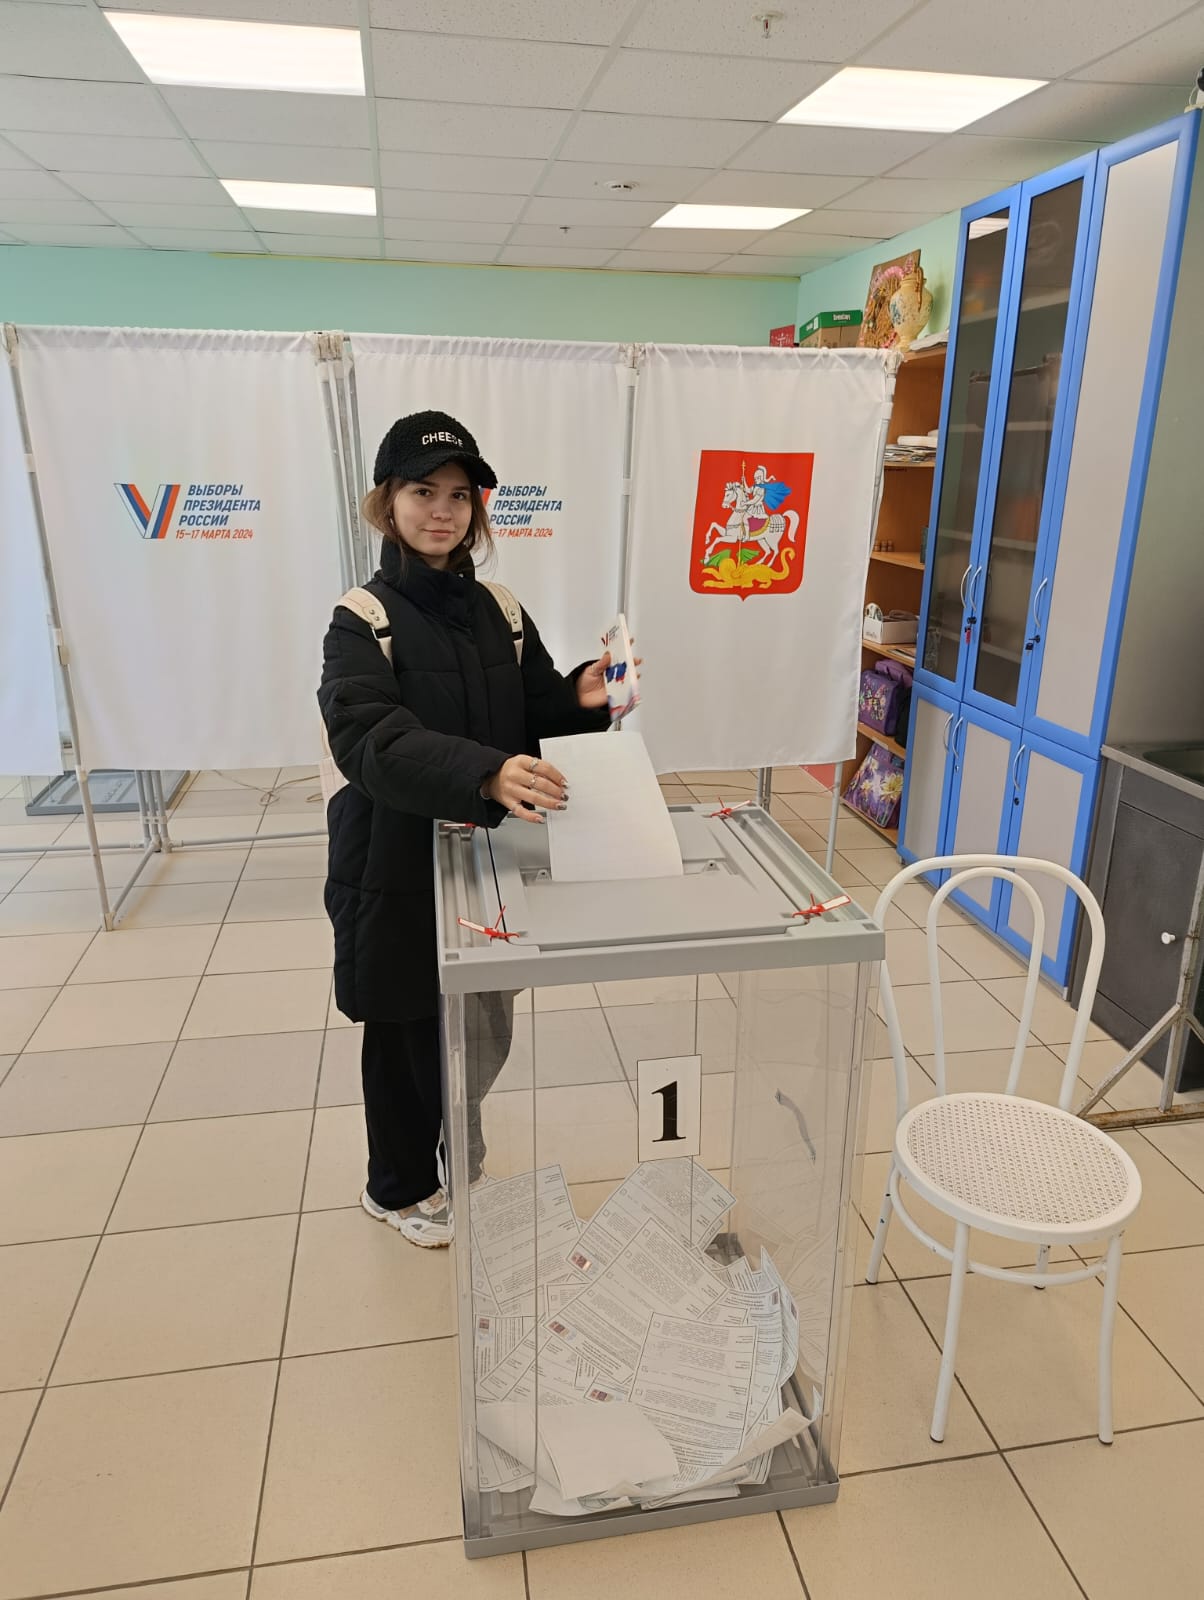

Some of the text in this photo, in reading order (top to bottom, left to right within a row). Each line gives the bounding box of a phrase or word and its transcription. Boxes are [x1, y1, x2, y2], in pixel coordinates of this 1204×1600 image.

[187, 484, 243, 496] ВЫБОРЫ
[498, 485, 547, 497] ВЫБОРЫ
[183, 499, 261, 513] ПРЕЗИДЕНТА
[493, 500, 562, 512] ПРЕЗИДЕНТА
[178, 514, 229, 526] РОССИИ
[489, 514, 532, 525] РОССИИ
[201, 529, 231, 539] МАРТА
[232, 529, 253, 539] 2024
[507, 527, 533, 537] МАРТА
[534, 528, 553, 537] 2024
[651, 1080, 687, 1142] 1
